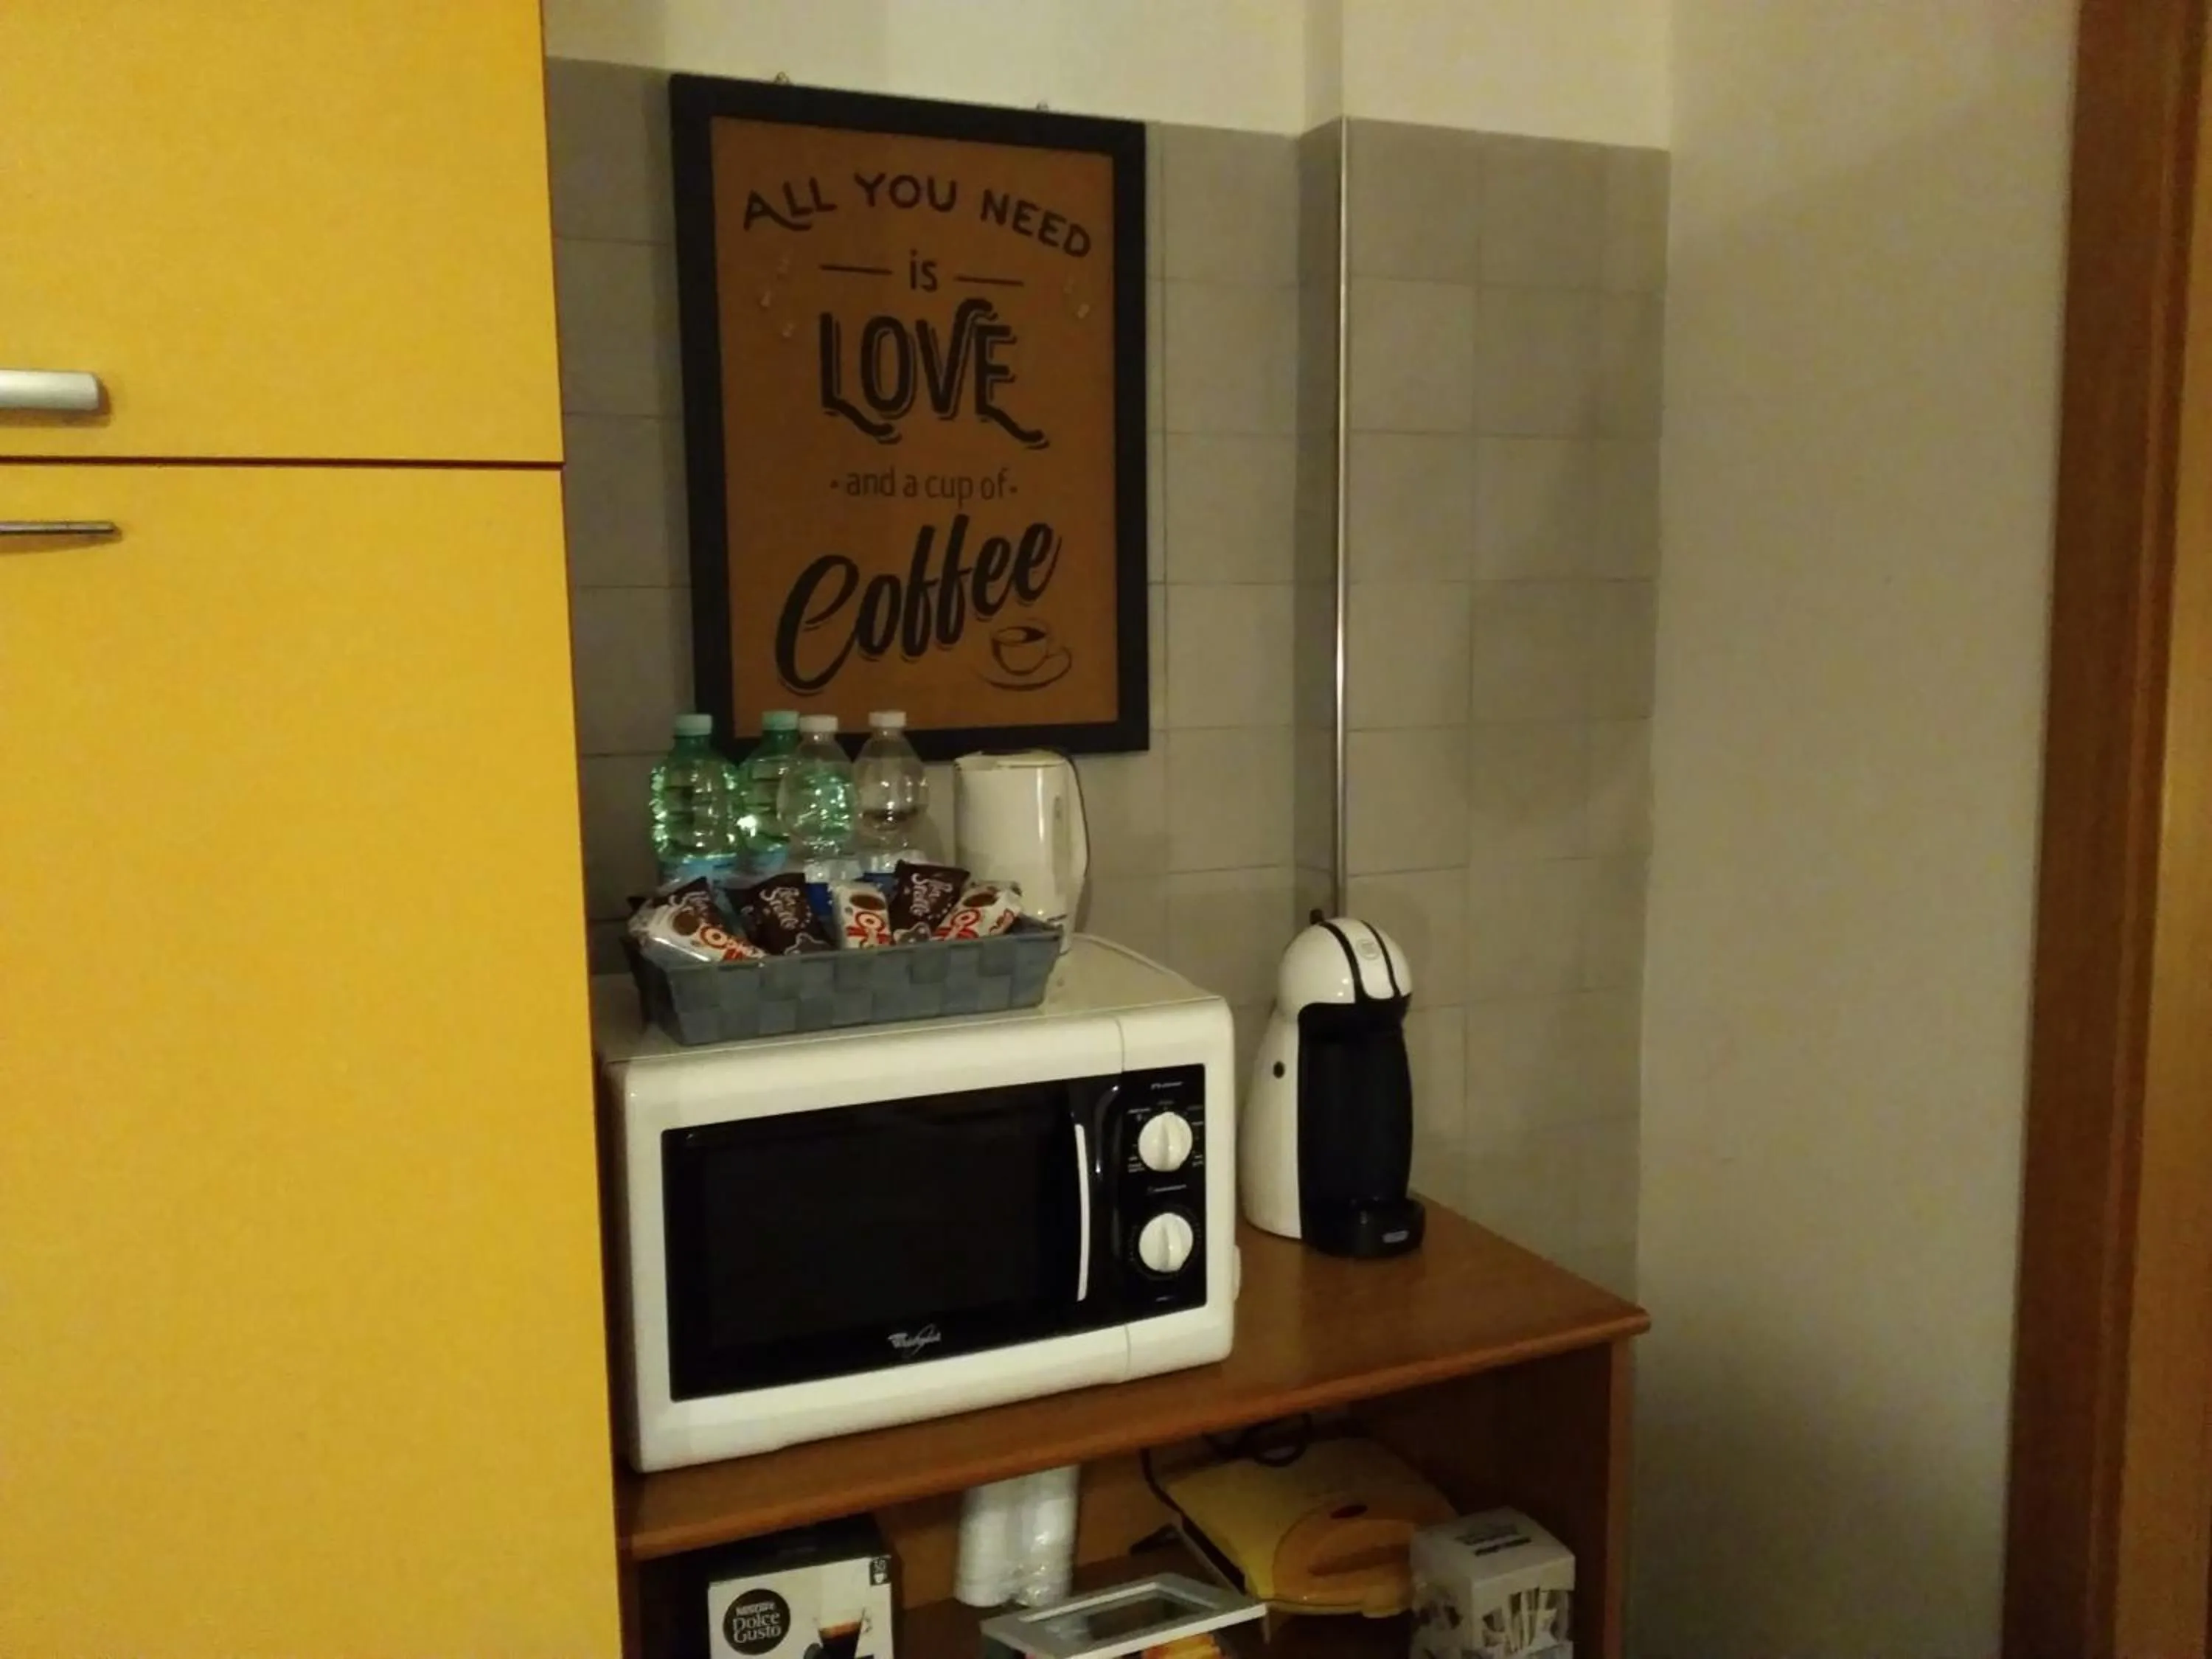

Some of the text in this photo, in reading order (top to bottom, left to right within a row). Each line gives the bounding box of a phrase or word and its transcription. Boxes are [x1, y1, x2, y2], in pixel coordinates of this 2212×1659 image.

[743, 173, 1091, 257] ALL YOU NEED
[909, 249, 938, 291] is
[818, 298, 1050, 448] LOVE
[846, 467, 1009, 509] and a cup of
[774, 514, 1062, 697] Coffee
[732, 1613, 781, 1632] Dolce
[734, 1624, 781, 1644] Gusto
